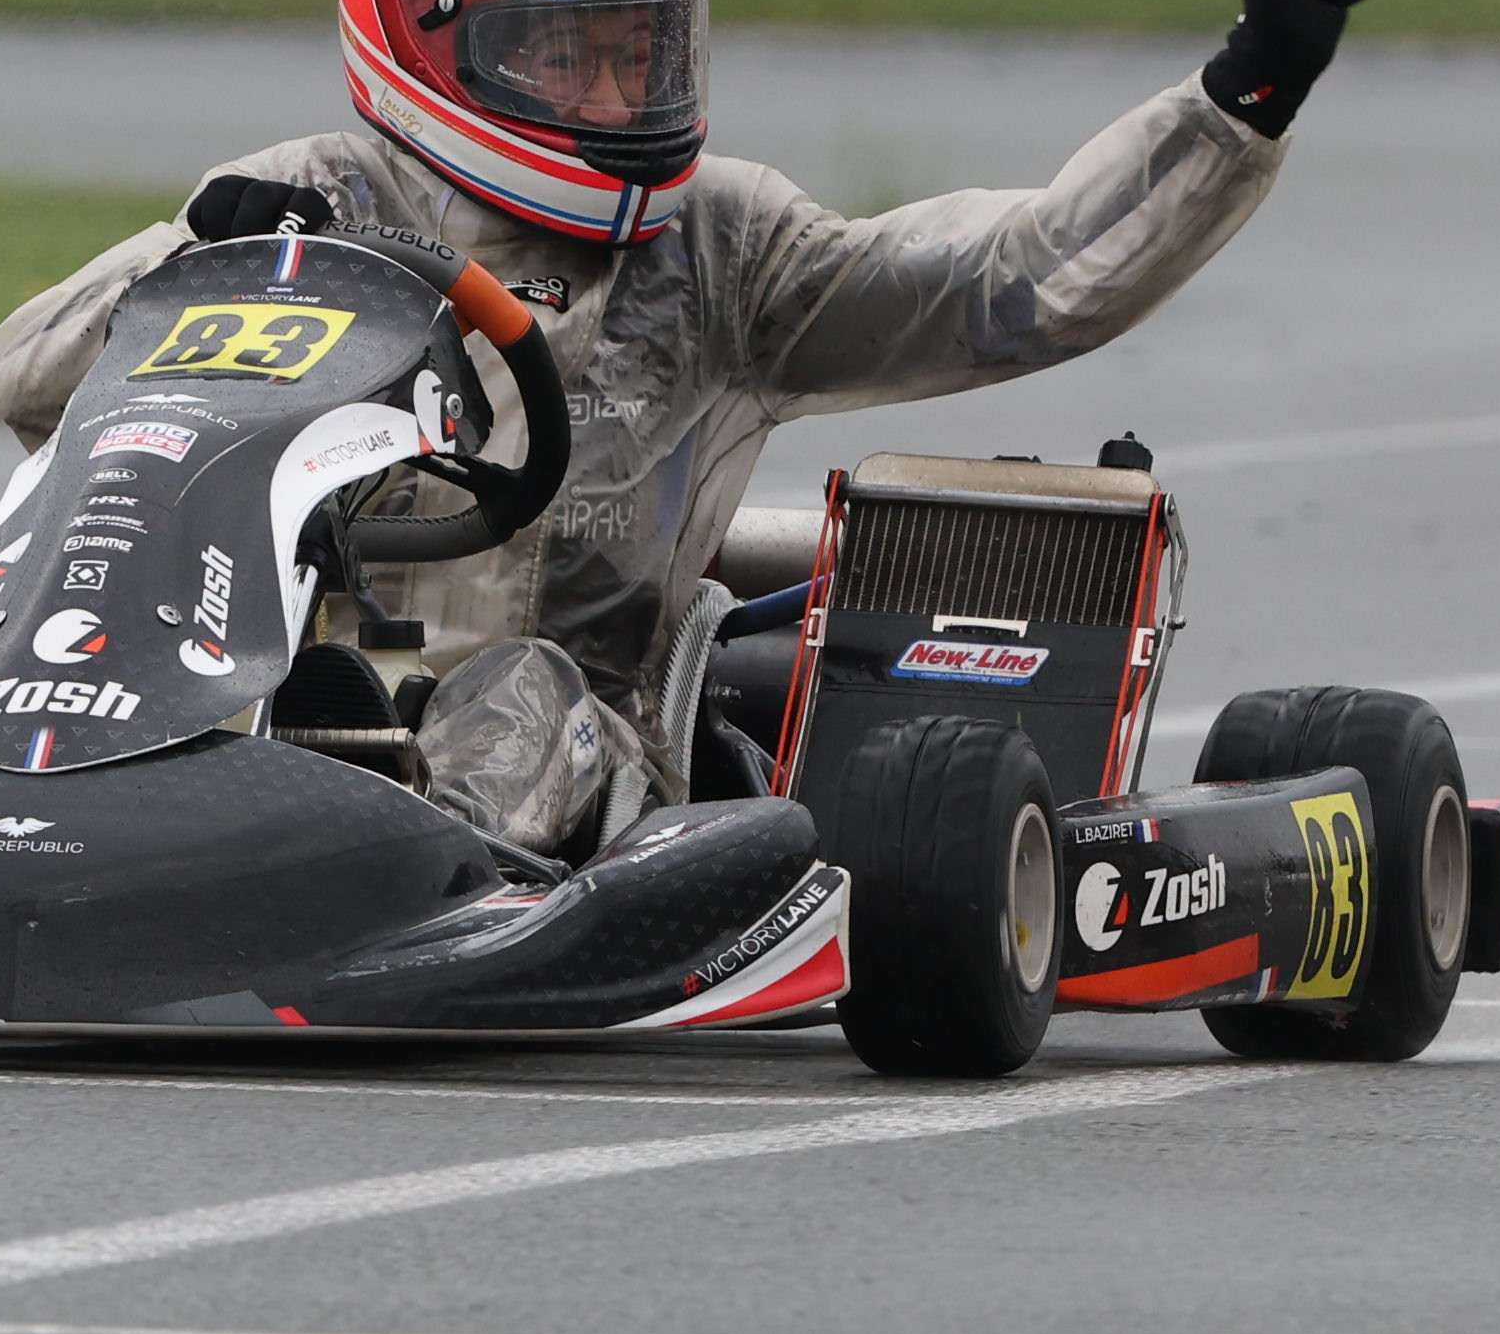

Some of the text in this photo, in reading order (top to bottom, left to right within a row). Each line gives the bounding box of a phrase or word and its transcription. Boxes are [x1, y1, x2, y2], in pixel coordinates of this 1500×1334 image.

[231, 293, 322, 303] #VICTORYLANE
[151, 313, 329, 368] 83
[79, 403, 240, 432] KARTREPUBLIC
[303, 430, 394, 474] #VICTORYLANE
[95, 469, 131, 480] BELL
[905, 643, 1038, 671] New-Line
[1075, 821, 1134, 844] L.BAZIRET
[1140, 853, 1226, 927] Zosh
[1301, 811, 1364, 983] 83
[680, 882, 828, 997] #VICTORYLANE
